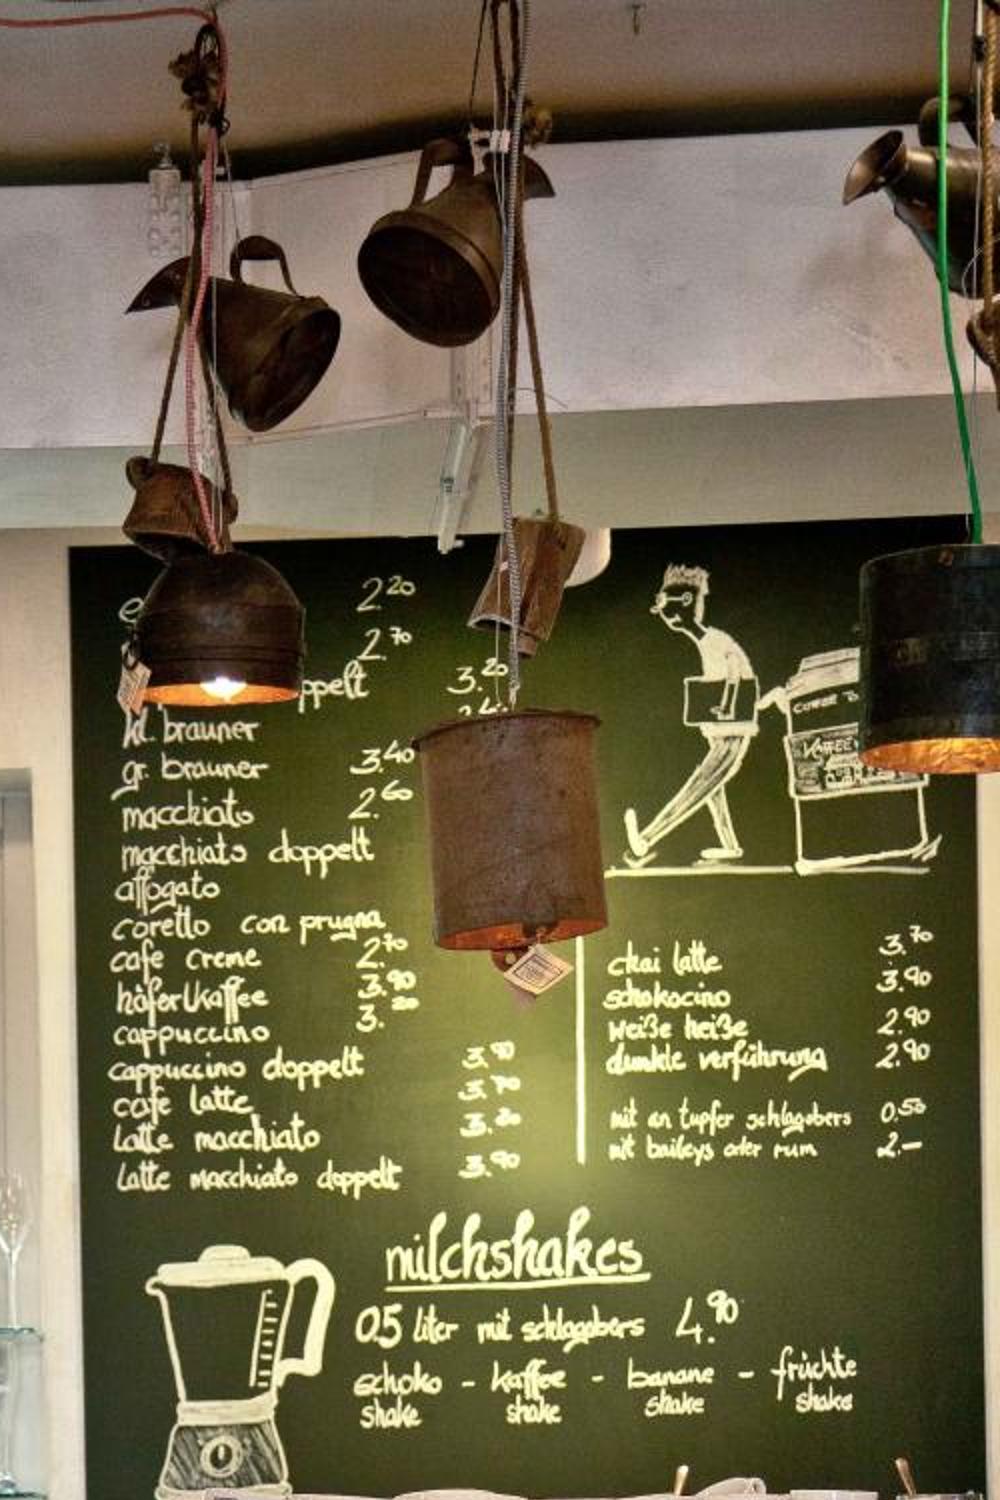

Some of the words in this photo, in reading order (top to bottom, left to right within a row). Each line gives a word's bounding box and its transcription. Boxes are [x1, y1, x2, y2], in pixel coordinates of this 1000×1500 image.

[356, 575, 417, 612] 2.20
[356, 626, 413, 661] 2.70
[299, 661, 369, 713] ppelt
[162, 705, 260, 745] brauner
[111, 760, 150, 801] gr.
[161, 751, 270, 781] brauner
[350, 739, 415, 774] 3.40
[122, 788, 255, 832] macchiato
[348, 780, 413, 819] 2.60
[121, 832, 248, 873] macchiato
[268, 827, 375, 880] doppelt
[114, 866, 221, 915] affogato
[112, 905, 212, 942] coretto
[240, 914, 291, 935] con
[300, 910, 386, 945] prugna
[879, 925, 935, 956] 3.70
[185, 946, 263, 972] creme
[607, 940, 662, 976] chai
[673, 940, 723, 976] latte
[602, 978, 732, 1011] schokocino
[875, 965, 933, 993] 3.90
[876, 1005, 931, 1036] 2.90
[113, 1024, 270, 1058] cappuccino
[605, 1042, 688, 1075] dunkle
[699, 1039, 828, 1082] verführung
[875, 1037, 931, 1069] 2.90
[107, 1053, 247, 1093] cappuccino
[261, 1046, 366, 1091] doppelt
[189, 1085, 254, 1115] latte
[610, 1096, 638, 1130] mit
[679, 1096, 735, 1137] tupfer
[880, 1097, 927, 1123] 0.50
[113, 1124, 174, 1153] latte
[195, 1112, 321, 1152] macchiato
[608, 1132, 636, 1161] mit
[646, 1133, 715, 1167] baileys
[722, 1134, 763, 1159] oder
[773, 1141, 819, 1159] rum
[116, 1161, 172, 1192] latte
[189, 1157, 299, 1189] macchiato
[316, 1155, 403, 1200] doppelt
[385, 1206, 644, 1284] milchshakes
[412, 1303, 459, 1344] liter
[477, 1306, 513, 1344] mit
[675, 1290, 739, 1344] 4.90
[353, 1359, 443, 1396] schoko
[491, 1357, 567, 1402] kaffee
[628, 1357, 715, 1390] banane
[360, 1396, 423, 1429] shake
[506, 1395, 562, 1424] shake
[644, 1388, 705, 1417] shake
[795, 1381, 853, 1413] shake
